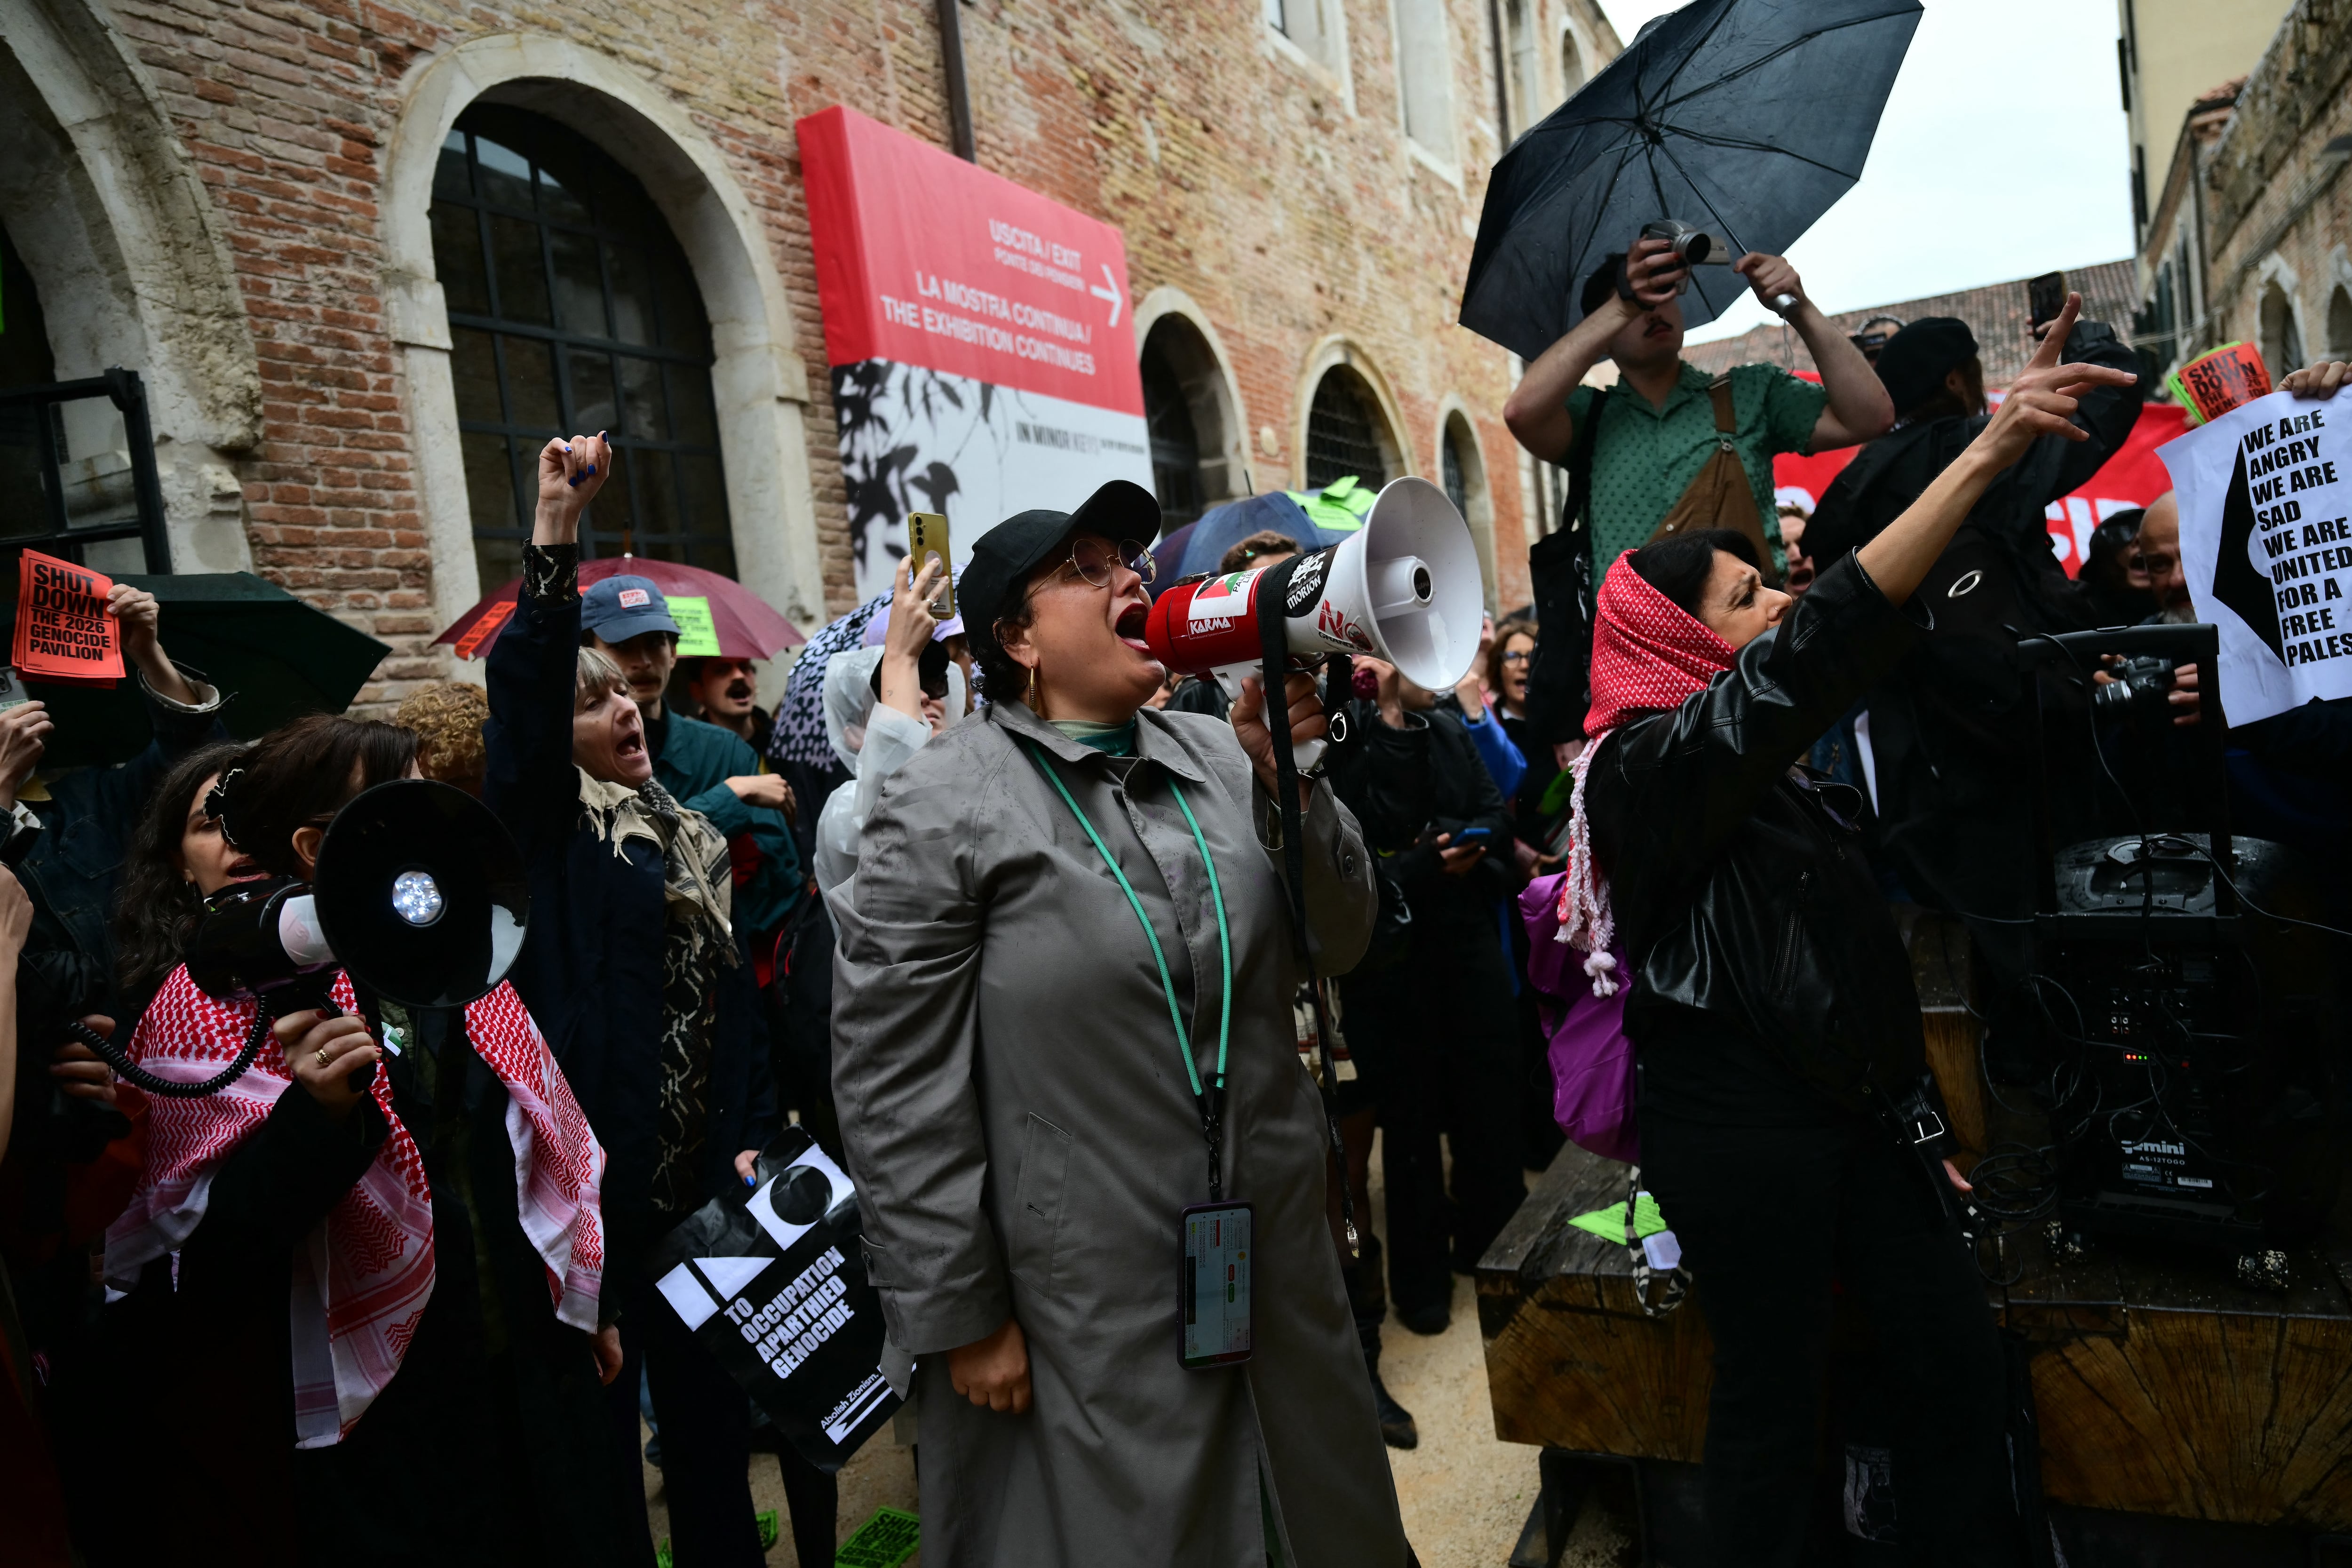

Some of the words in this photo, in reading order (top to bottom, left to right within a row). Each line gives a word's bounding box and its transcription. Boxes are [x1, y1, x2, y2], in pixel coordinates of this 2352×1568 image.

[989, 219, 1041, 256] USCITA
[1052, 243, 1081, 272] EXIT
[915, 271, 942, 300] LA
[942, 279, 1012, 321] MOSTRA
[1012, 302, 1085, 344] CONTINUA
[880, 294, 921, 328] THE
[922, 307, 1014, 354] EXHIBITION
[1015, 334, 1096, 375] CONTINUES
[2188, 351, 2240, 383] SHUT
[2194, 362, 2257, 398] DOWN
[2202, 389, 2224, 408] THE
[1016, 421, 1032, 444] IN
[1032, 424, 1069, 450] MINOR
[2243, 423, 2275, 454] WE
[2280, 409, 2325, 439] ARE
[2250, 436, 2320, 481] ANGRY
[2251, 476, 2286, 506] WE
[2290, 461, 2338, 493] ARE
[2257, 500, 2302, 532] SAD
[2263, 529, 2298, 559] WE
[2302, 517, 2352, 548] ARE
[34, 564, 94, 596] SHUT
[2271, 546, 2352, 585] UNITED
[33, 584, 105, 619] DOWN
[2276, 583, 2319, 613] FOR
[2324, 577, 2343, 601] A
[30, 624, 111, 648] GENOCIDE
[31, 608, 60, 627] THE
[65, 616, 105, 634] 2026
[1189, 617, 1232, 635] KARMA
[2281, 608, 2336, 640] FREE
[30, 639, 103, 661] PAVILION
[2121, 1140, 2185, 1156] gemini
[723, 1297, 754, 1326] TO
[740, 1245, 846, 1344] OCCUPATION
[755, 1275, 848, 1364] APARTHIED
[771, 1297, 856, 1379] GENOCIDE
[820, 1398, 850, 1431] Abolish
[846, 1371, 880, 1403] Zionism.
[860, 1526, 919, 1546] DOWN
